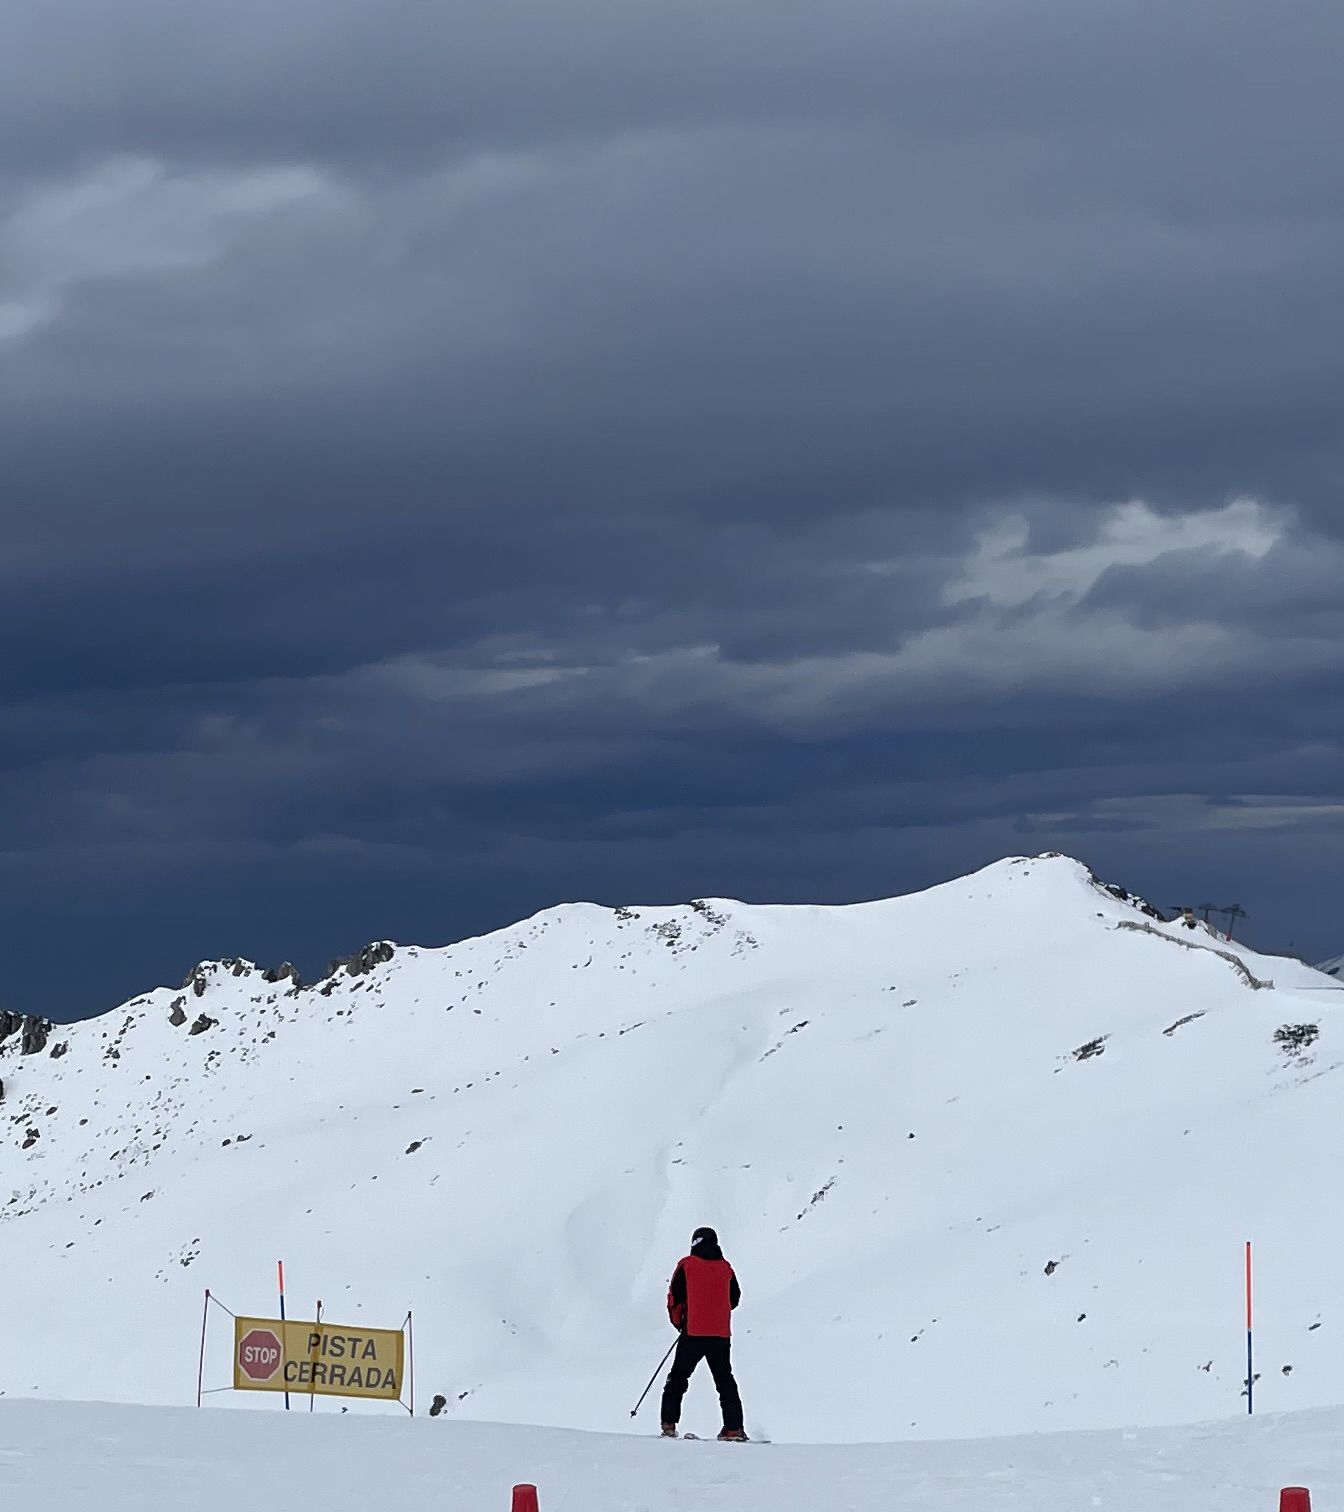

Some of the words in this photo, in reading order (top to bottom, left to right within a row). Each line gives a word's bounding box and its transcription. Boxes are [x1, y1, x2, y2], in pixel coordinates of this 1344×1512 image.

[244, 1345, 277, 1365] STOP
[307, 1332, 377, 1361] PISTA
[283, 1360, 397, 1389] CERRADA
